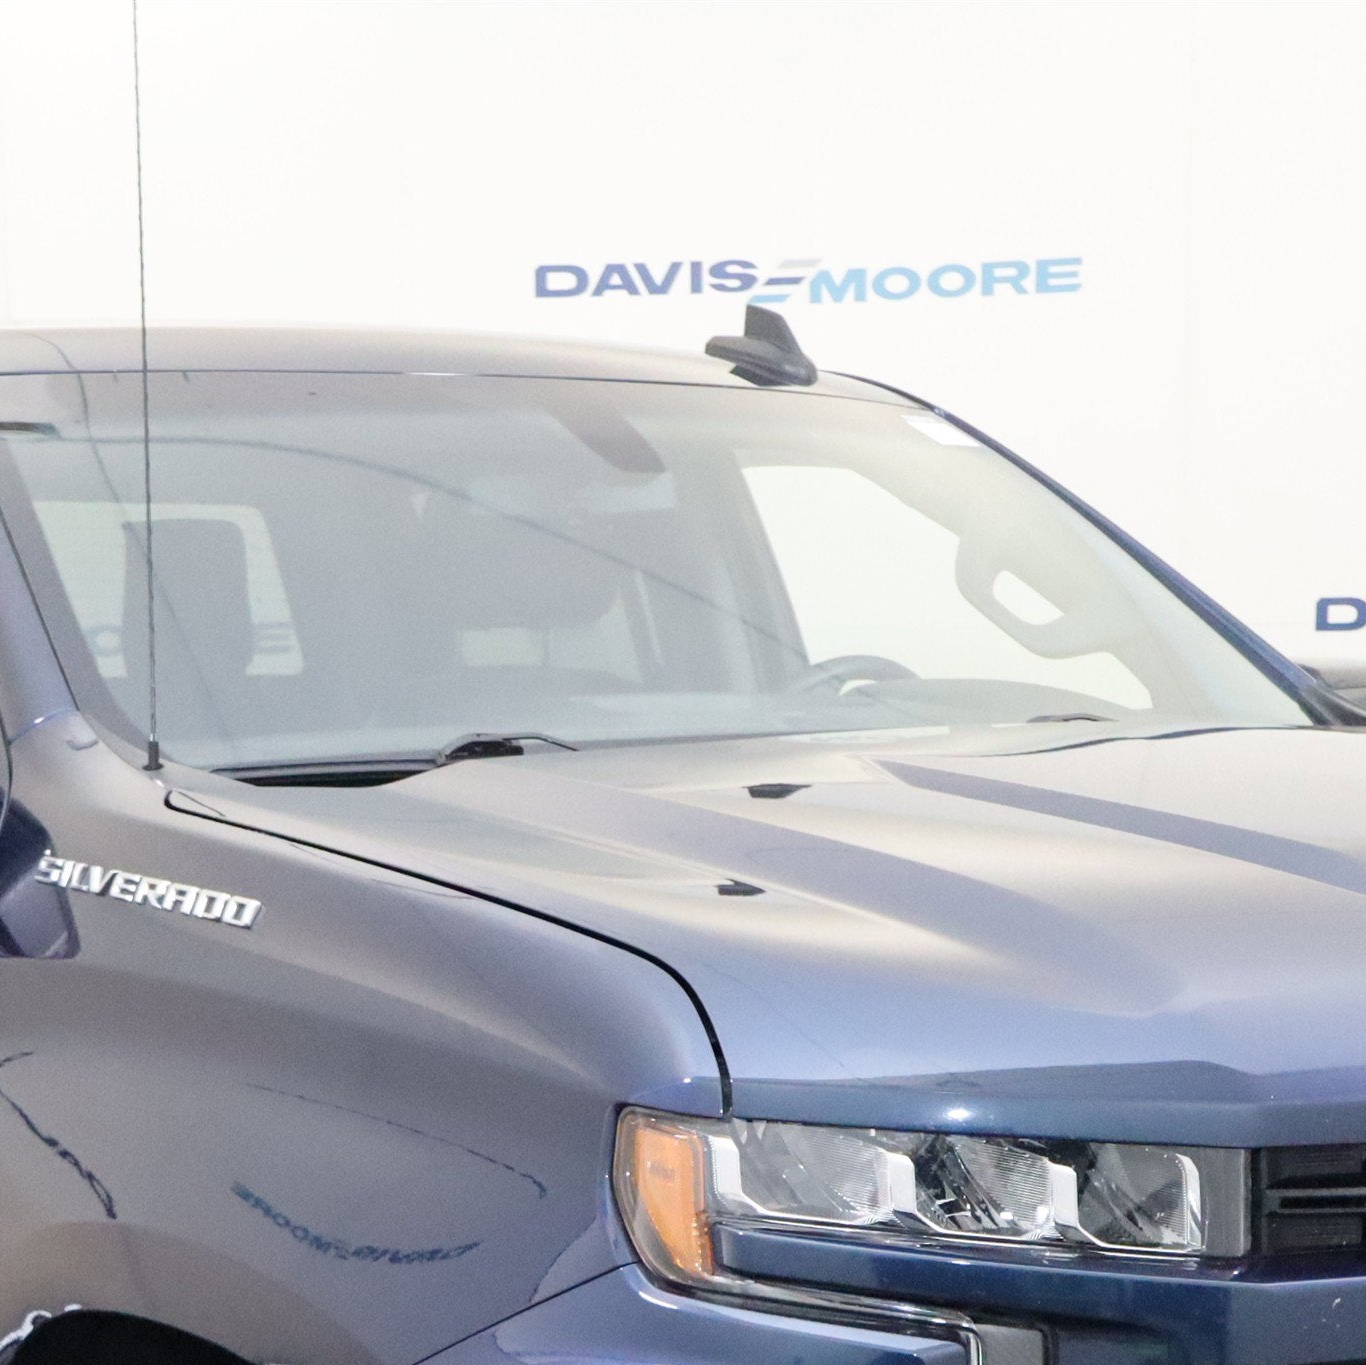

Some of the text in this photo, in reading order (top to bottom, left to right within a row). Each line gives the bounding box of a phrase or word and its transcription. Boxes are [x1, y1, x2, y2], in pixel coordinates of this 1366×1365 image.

[534, 257, 1083, 304] DAVIS MOORE
[33, 852, 264, 930] SILVERADO
